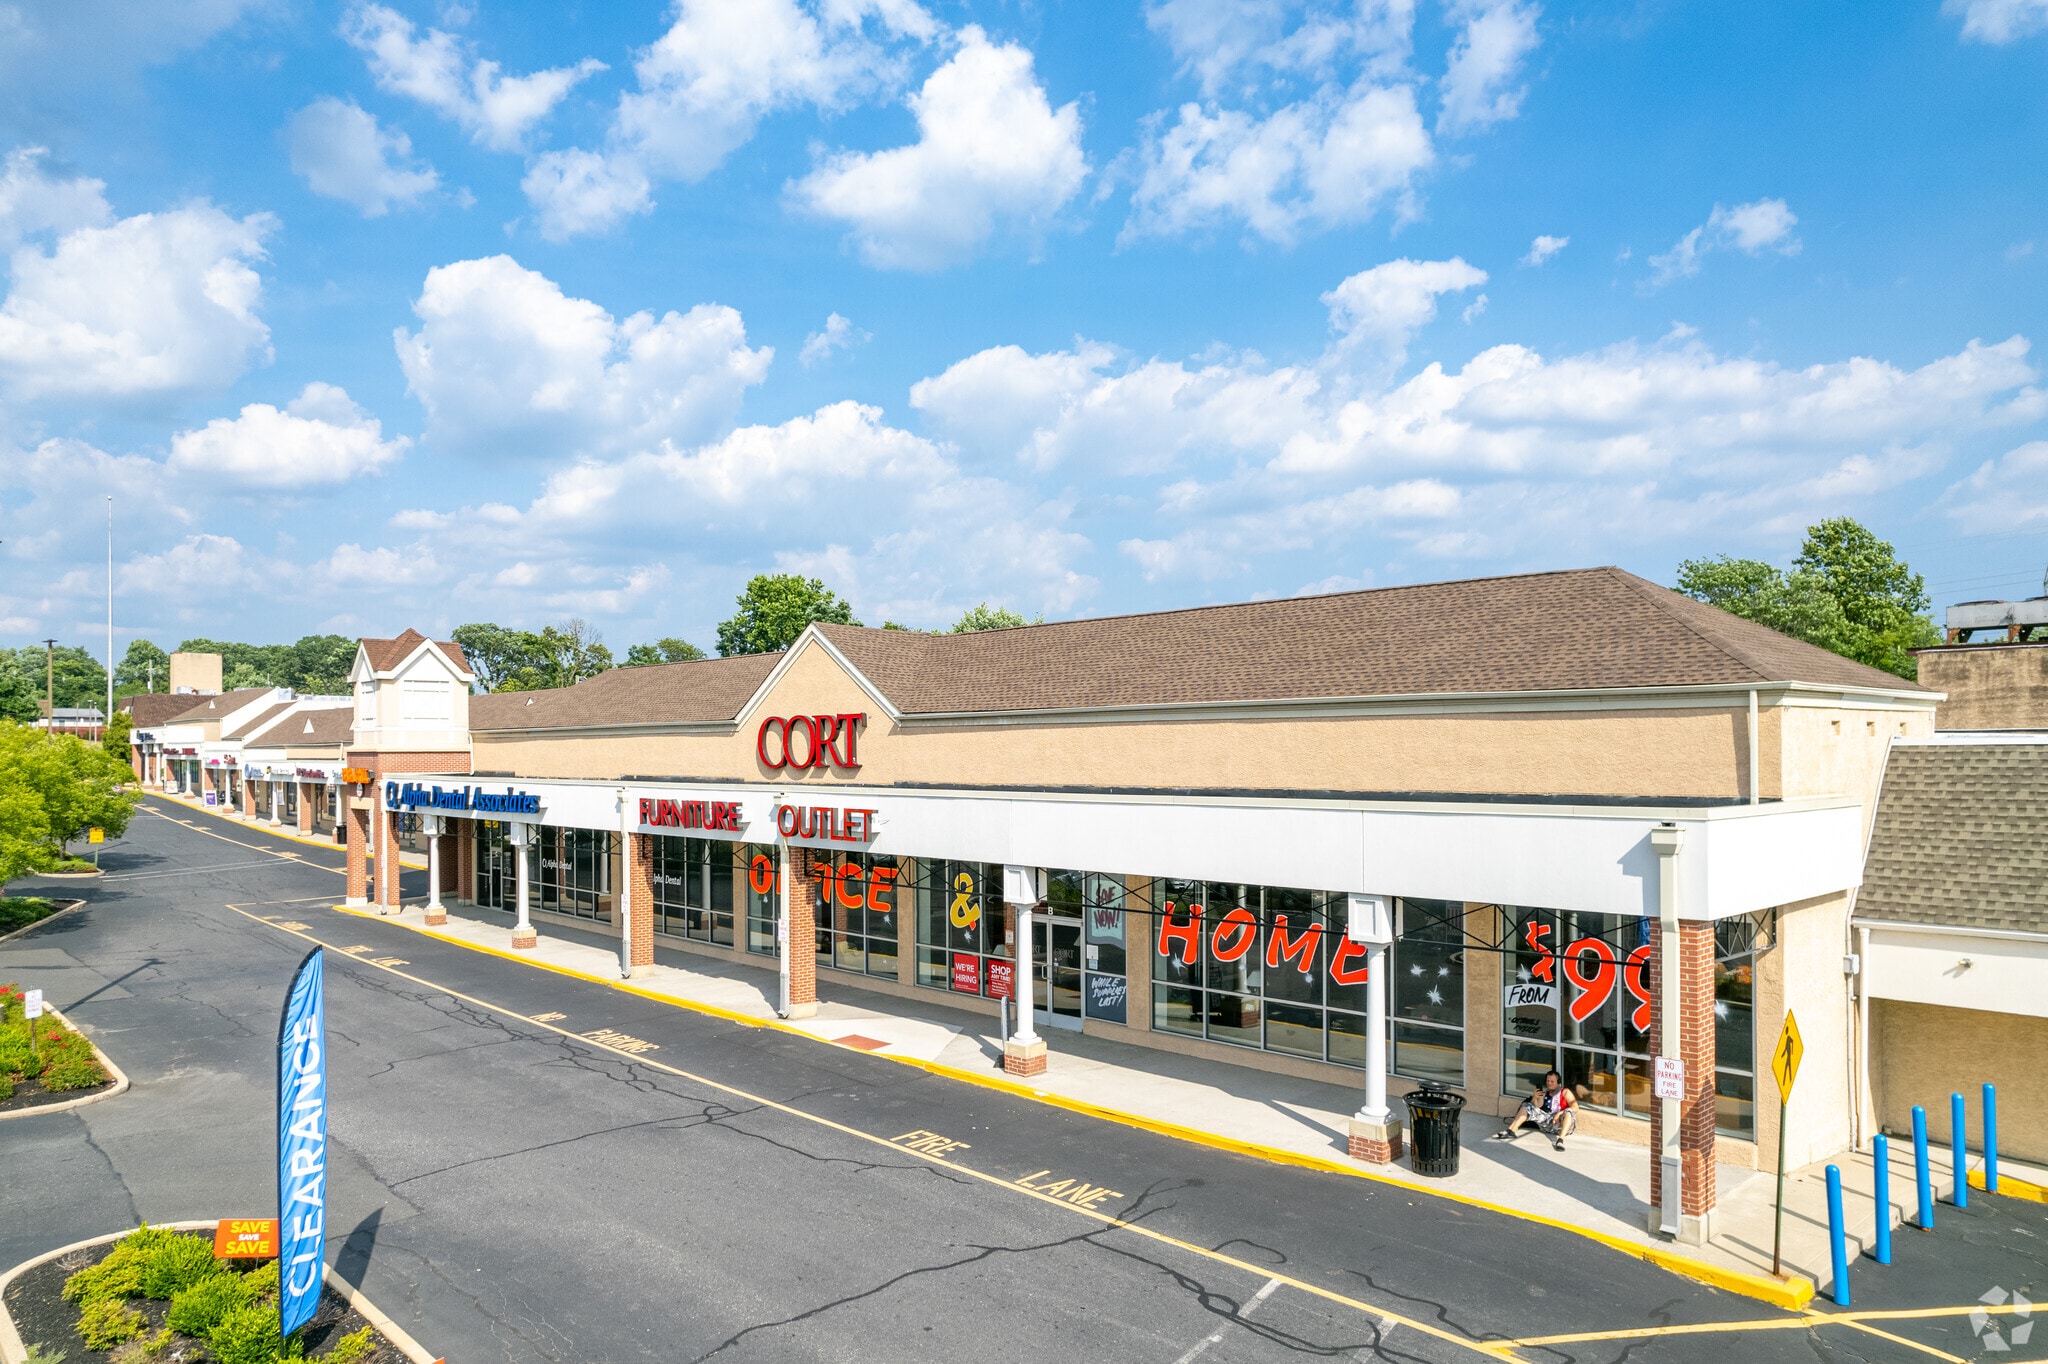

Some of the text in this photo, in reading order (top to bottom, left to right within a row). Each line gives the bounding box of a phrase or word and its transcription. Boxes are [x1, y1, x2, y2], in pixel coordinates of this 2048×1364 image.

[757, 713, 866, 770] CORT
[401, 783, 541, 814] Alpha Dental Associates
[639, 797, 743, 832] FURNITURE
[777, 804, 878, 843] OUTLET
[749, 854, 898, 913] OICE
[1094, 903, 1121, 930] NOW!
[1158, 901, 1369, 986] HOME
[955, 962, 975, 973] WE'RE
[955, 973, 977, 984] HIRING
[990, 964, 1011, 976] SHOP
[1508, 985, 1550, 1006] FROM
[580, 1027, 660, 1053] PARKING
[1657, 1070, 1682, 1081] PARKING
[1664, 1061, 1675, 1070] NO
[1661, 1088, 1679, 1097] LANE
[1662, 1080, 1677, 1089] FIRE
[288, 1012, 324, 1297] CLEARANCE
[890, 1129, 972, 1158] FIRE
[1014, 1169, 1124, 1209] LANE
[230, 1220, 270, 1234] SAVE
[238, 1233, 260, 1242] SAVE
[225, 1240, 270, 1255] SAVE
